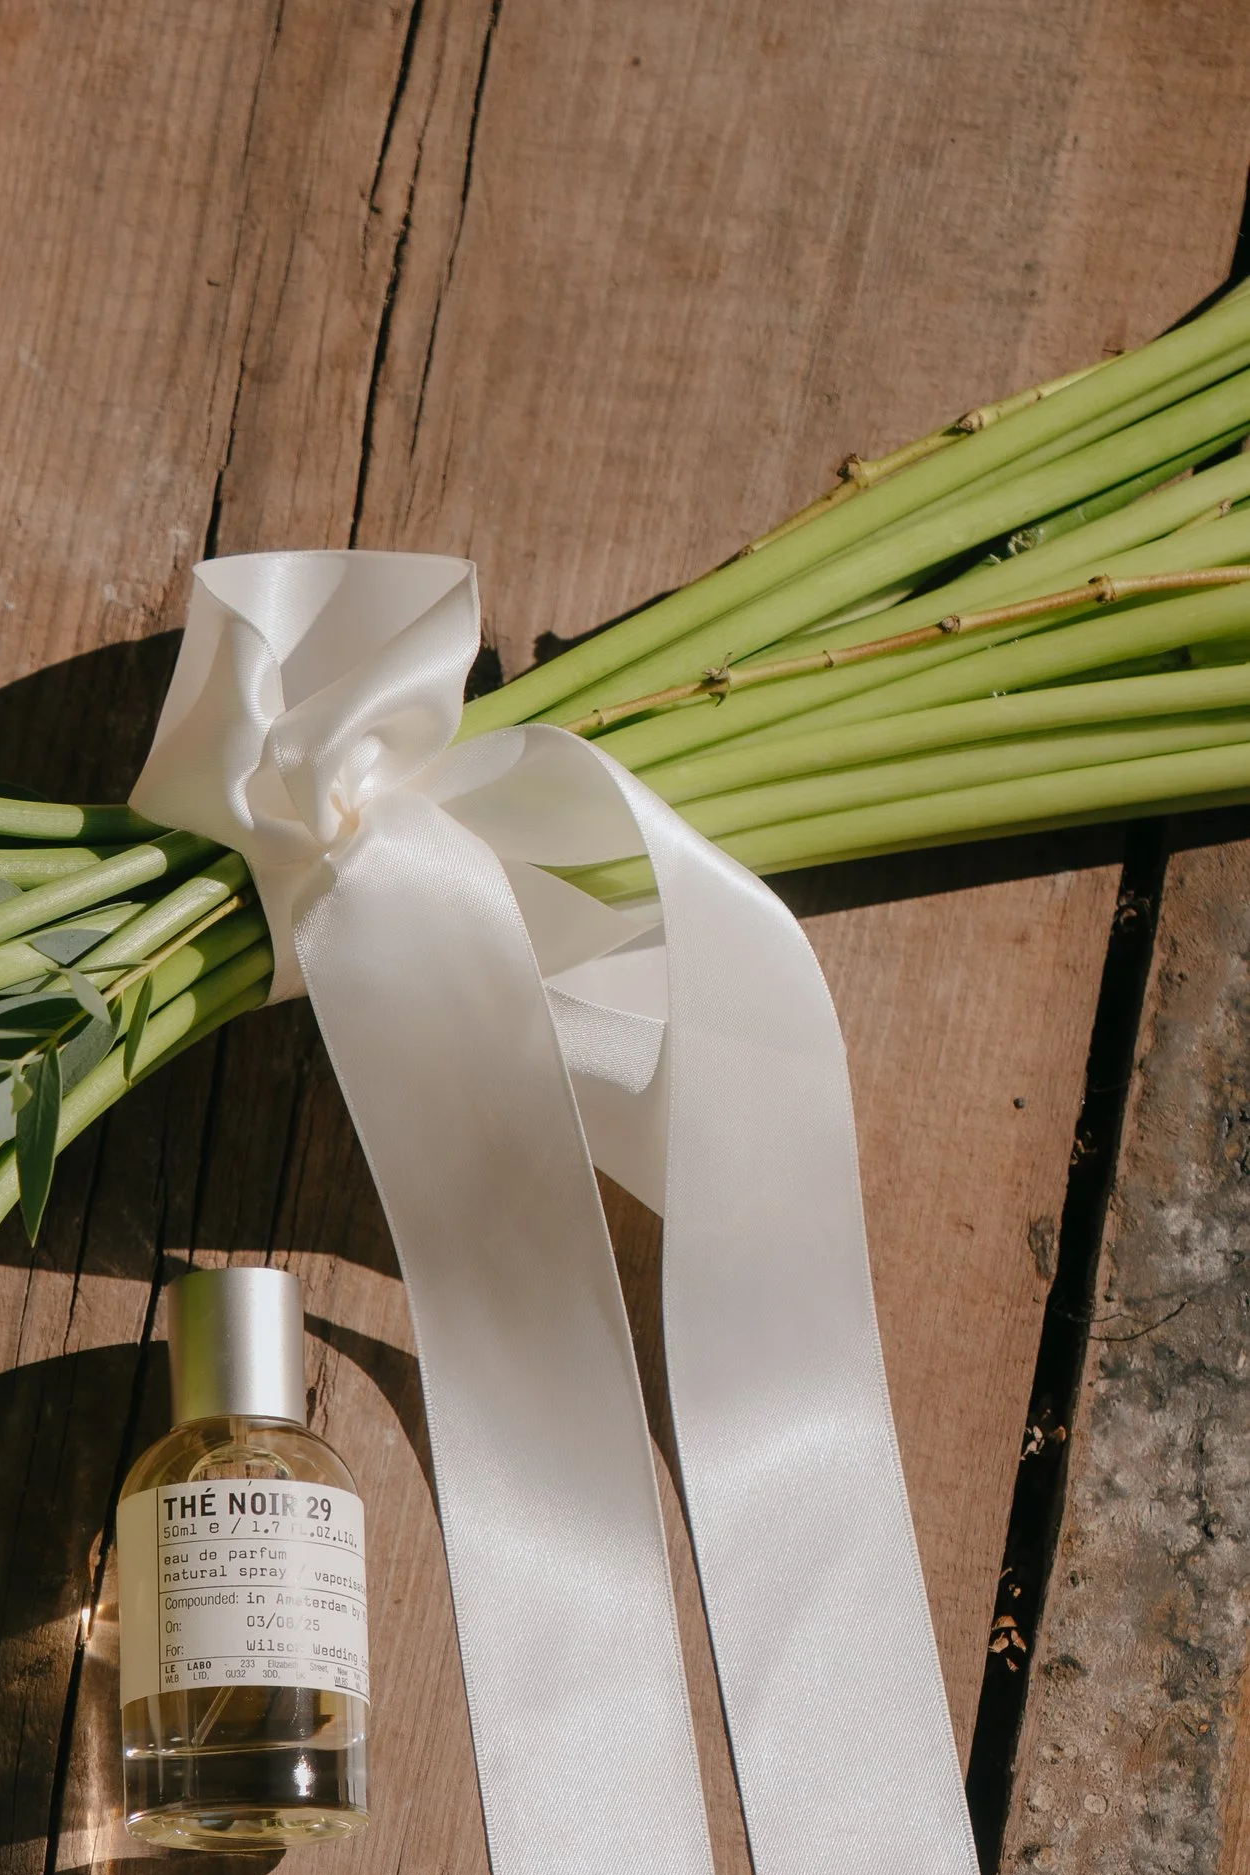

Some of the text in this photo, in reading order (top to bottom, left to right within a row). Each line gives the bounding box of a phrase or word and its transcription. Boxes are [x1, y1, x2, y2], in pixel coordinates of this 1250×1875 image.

[163, 1487, 331, 1521] THÉ NOIR 29
[164, 1524, 197, 1538] 50ml
[252, 1521, 280, 1534] 1.7
[164, 1547, 287, 1565] eau de parfum
[164, 1565, 227, 1583] natural
[239, 1567, 286, 1580] spray
[165, 1592, 239, 1610] Compounded:
[247, 1592, 265, 1604] in
[165, 1621, 182, 1633] On:
[166, 1645, 184, 1657] For:
[312, 1643, 357, 1665] Wedding
[165, 1664, 175, 1674] LE
[187, 1661, 212, 1671] LABO
[240, 1659, 255, 1668] 233
